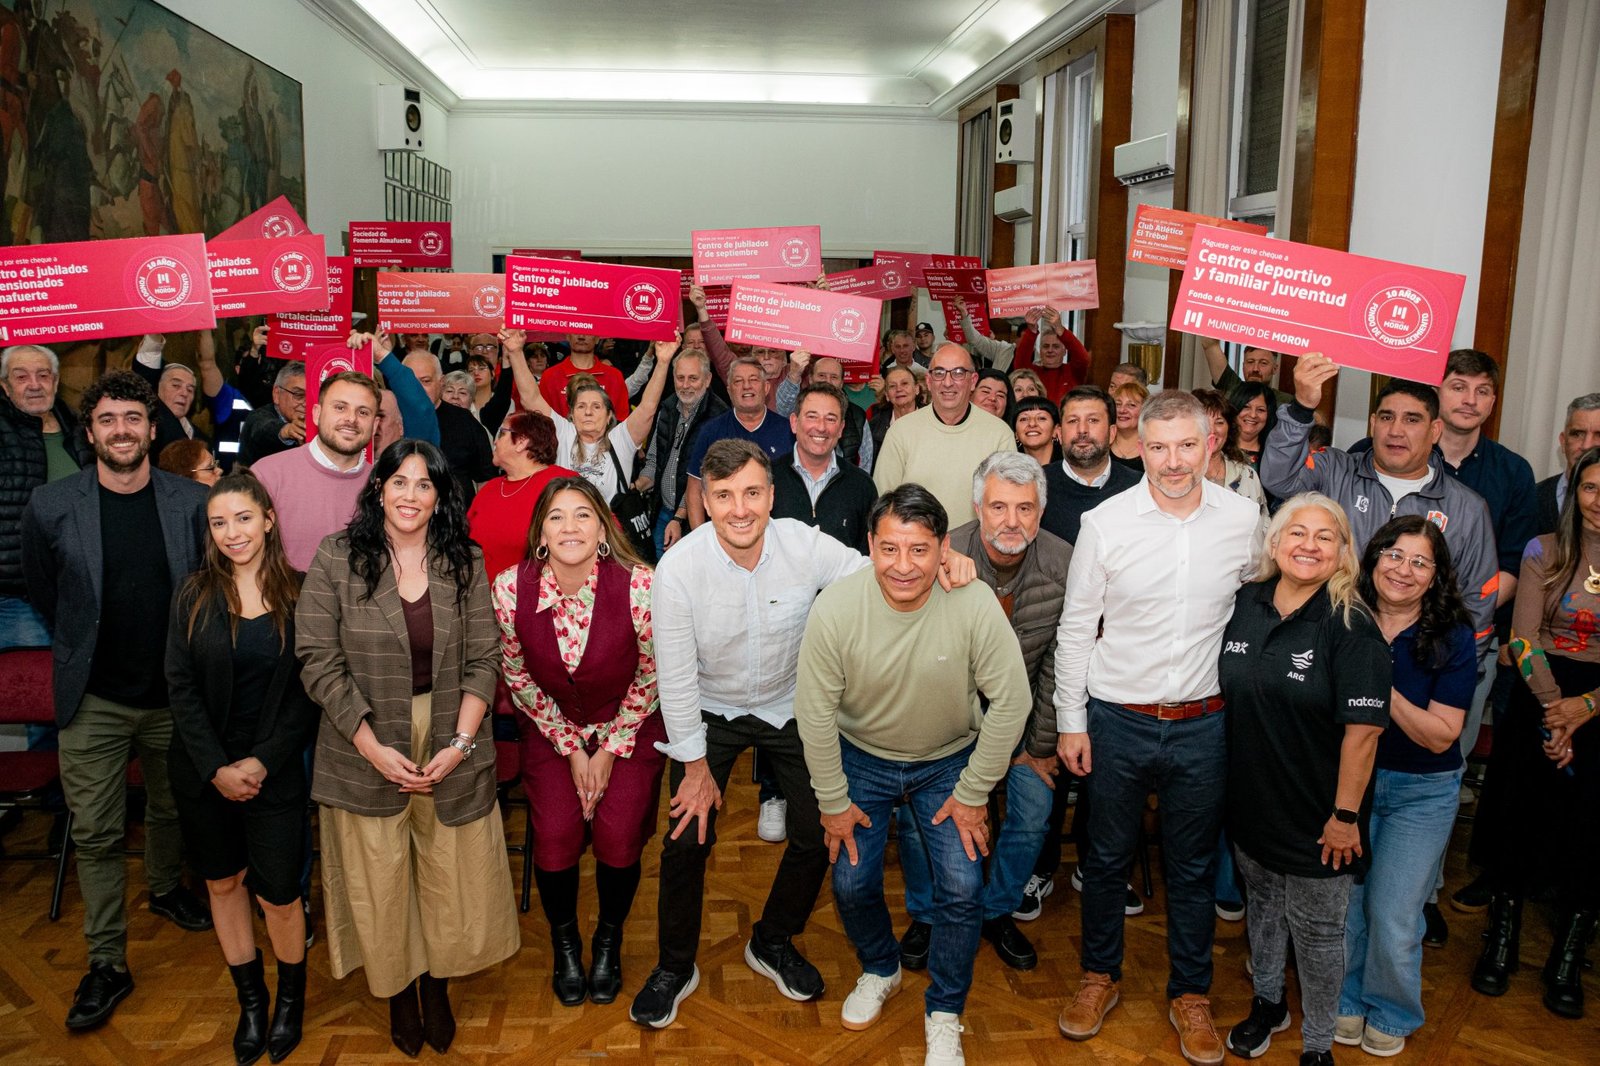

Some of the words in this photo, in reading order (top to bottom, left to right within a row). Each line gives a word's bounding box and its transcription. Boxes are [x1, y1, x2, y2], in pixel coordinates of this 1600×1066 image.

[1138, 222, 1153, 230] Club
[1155, 224, 1183, 235] Atlético
[1145, 231, 1168, 240] Trébol
[716, 249, 758, 258] septiembre
[1201, 238, 1229, 250] Páguese
[1231, 244, 1242, 252] por
[1243, 246, 1258, 256] este
[1259, 250, 1283, 261] cheque
[0, 270, 17, 279] tro
[20, 268, 34, 277] de
[215, 269, 226, 278] de
[229, 267, 258, 277] Moron
[1199, 249, 1250, 270] Centro
[1254, 260, 1332, 287] deportivo
[0, 278, 64, 291] ensionados
[512, 273, 546, 283] Centro
[548, 275, 560, 284] de
[829, 278, 849, 286] ociedad
[512, 283, 531, 293] San
[533, 285, 560, 297] Jorge
[1193, 267, 1205, 281] y
[1208, 267, 1270, 292] familiar
[1271, 280, 1347, 307] Juventud
[736, 292, 766, 304] Centro
[768, 296, 779, 306] de
[1188, 289, 1213, 301] Fondo
[1215, 294, 1225, 303] de
[1226, 297, 1289, 317] Fortalecimiento
[1385, 290, 1398, 299] 10
[1398, 289, 1421, 304] AÑOS
[21, 303, 77, 313] Fortalecimiento
[222, 302, 246, 310] MORON
[537, 302, 577, 311] Fortalecimiento
[735, 302, 764, 314] Haedo
[766, 308, 780, 316] sur
[1368, 302, 1378, 327] FONDO
[13, 327, 56, 337] MUNICIPIO
[58, 325, 69, 333] DE
[71, 322, 103, 332] MORON
[528, 318, 558, 326] MUNICIPIO
[569, 321, 593, 329] MORON
[1379, 313, 1429, 346] FORTALECIMIENTO
[1384, 321, 1409, 331] MORON
[1207, 318, 1255, 336] MUNICIPIO
[1257, 329, 1269, 339] DE
[1272, 332, 1310, 347] MORON
[1371, 326, 1382, 337] DE
[744, 333, 772, 343] MUNICIPIO
[780, 339, 802, 347] MORON
[1223, 641, 1249, 655] pax
[1287, 671, 1305, 681] ARG
